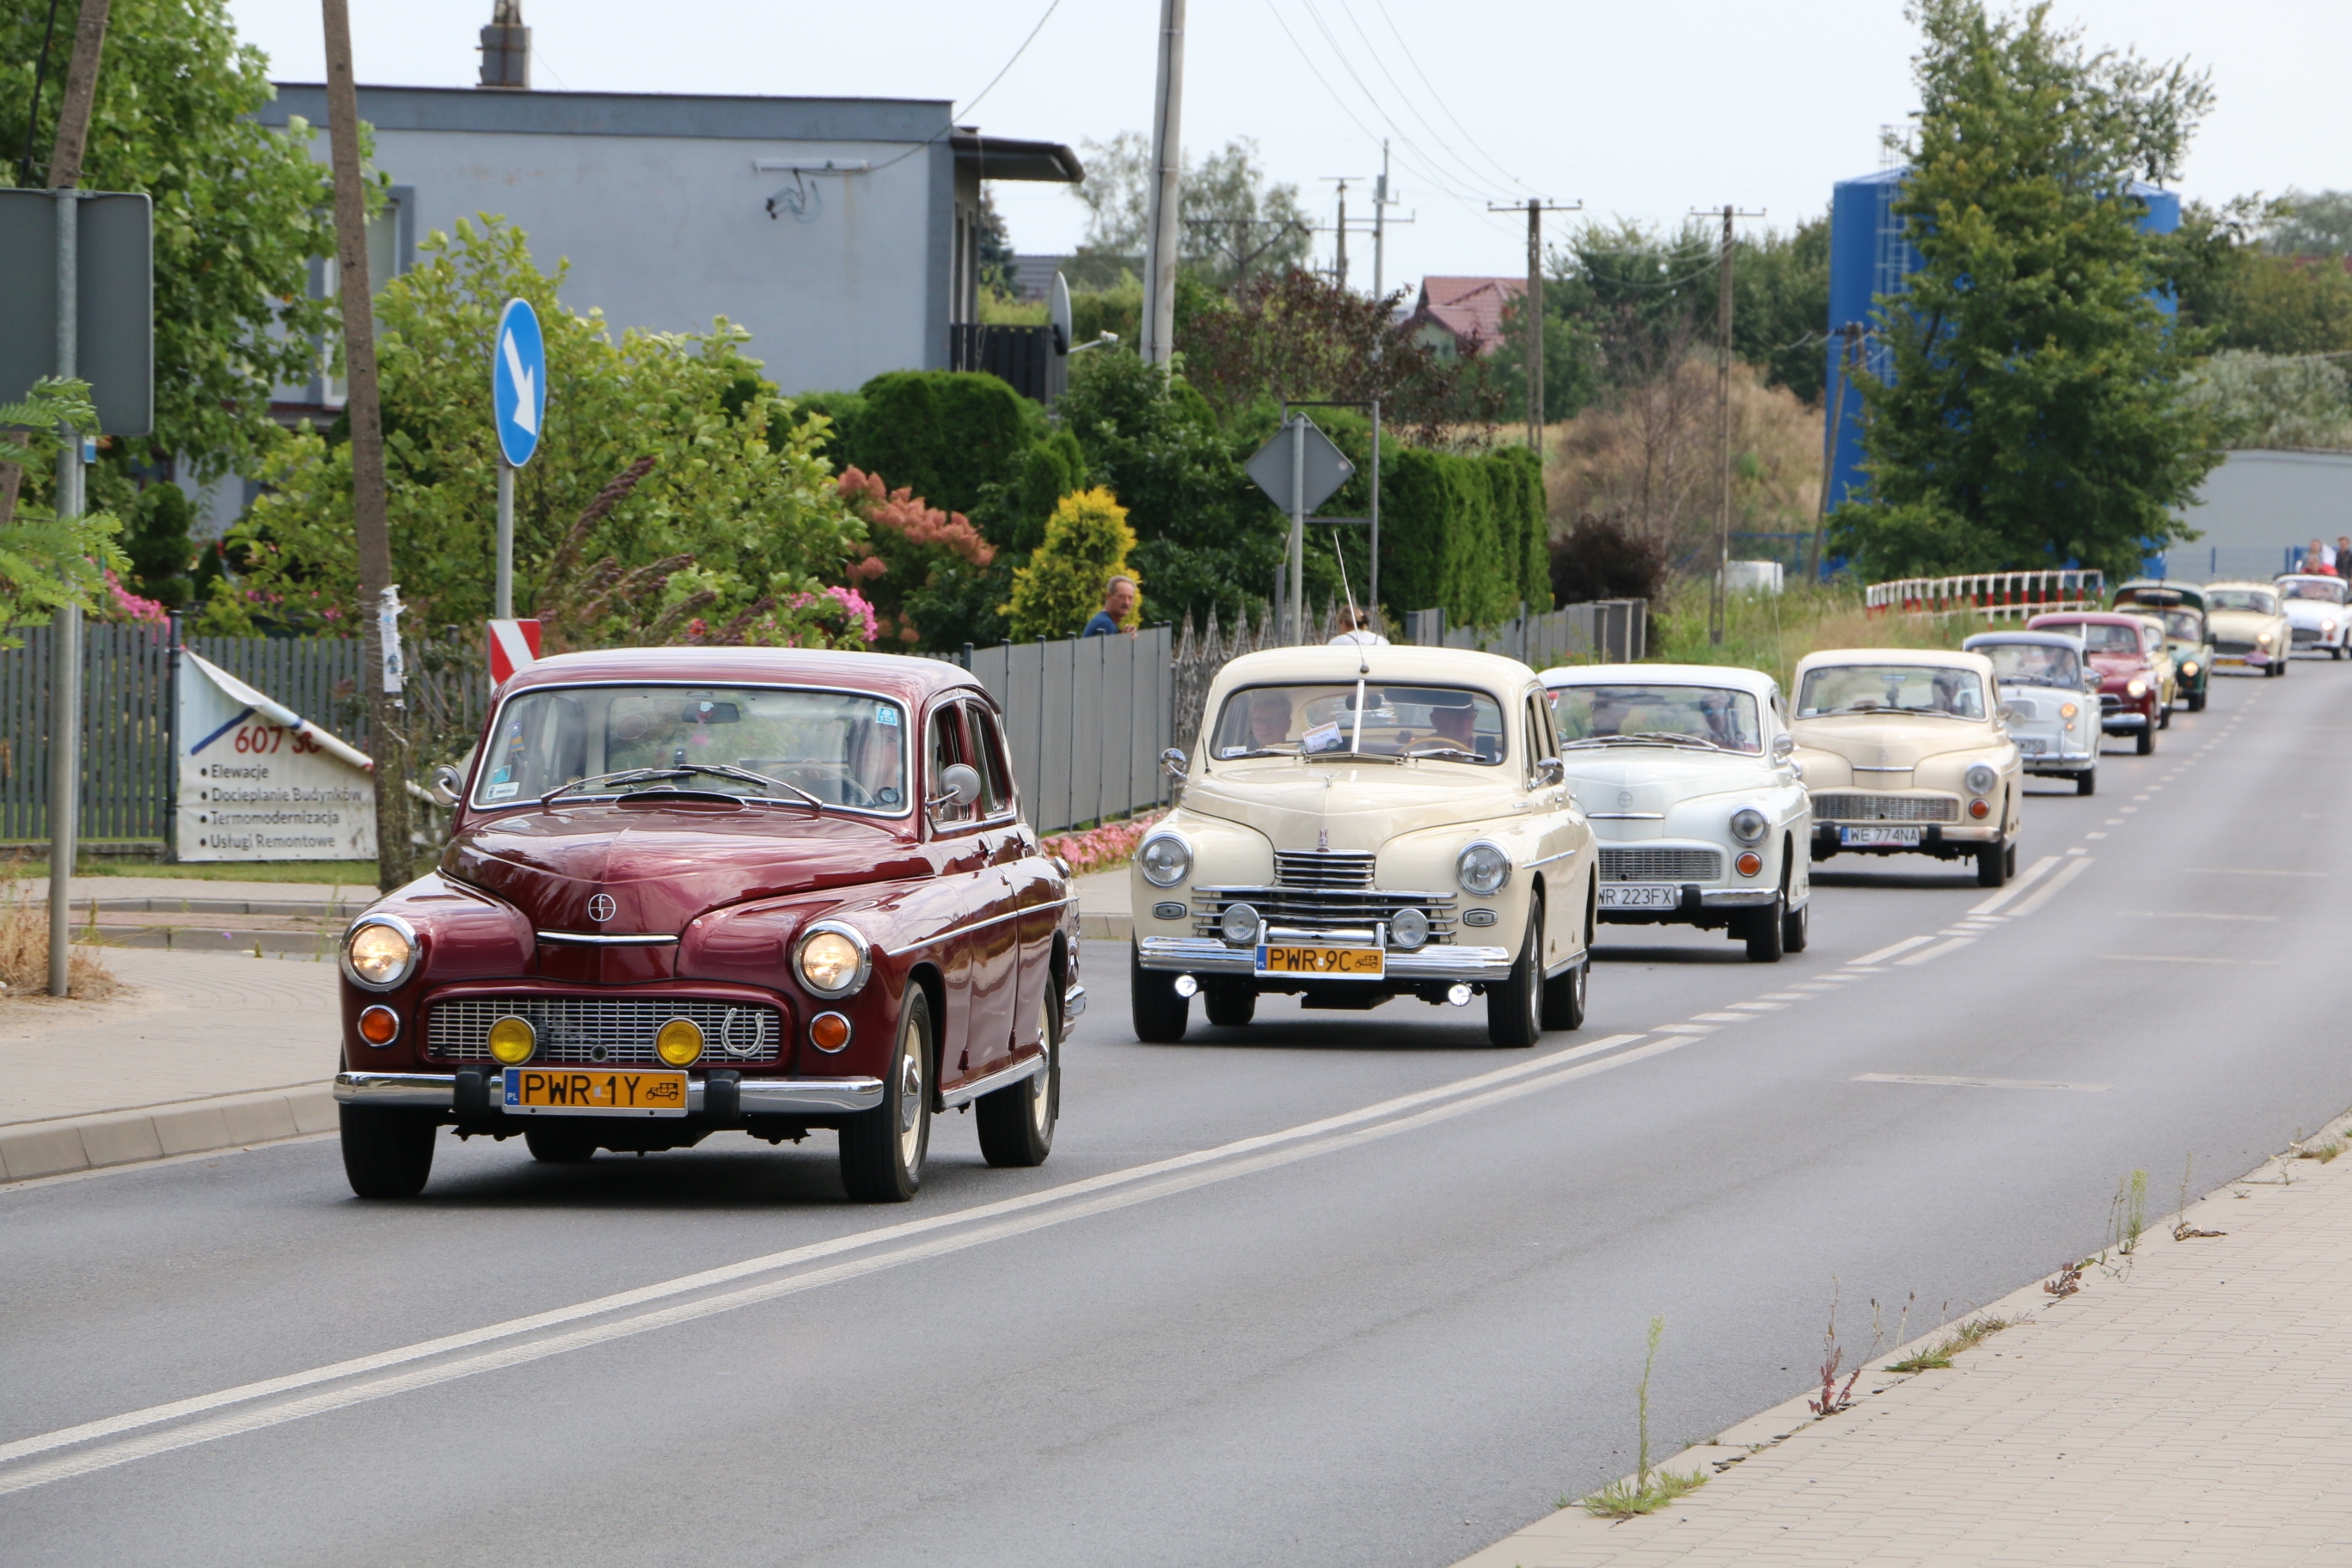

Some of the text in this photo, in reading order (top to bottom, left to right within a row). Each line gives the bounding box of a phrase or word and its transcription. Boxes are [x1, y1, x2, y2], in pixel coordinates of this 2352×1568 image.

[235, 726, 283, 754] 607
[211, 764, 269, 781] Elewacje
[212, 787, 363, 804] Docieplanie Budynków
[211, 810, 340, 827] Termomodernizacja
[210, 834, 335, 850] Usługi Remontowe
[1850, 828, 1870, 842] WE
[1876, 829, 1918, 842] 774NA
[1621, 888, 1672, 905] 223FX
[1270, 948, 1352, 972] PWR 9C
[506, 1093, 518, 1101] PL
[524, 1074, 640, 1106] PWR 1Y
